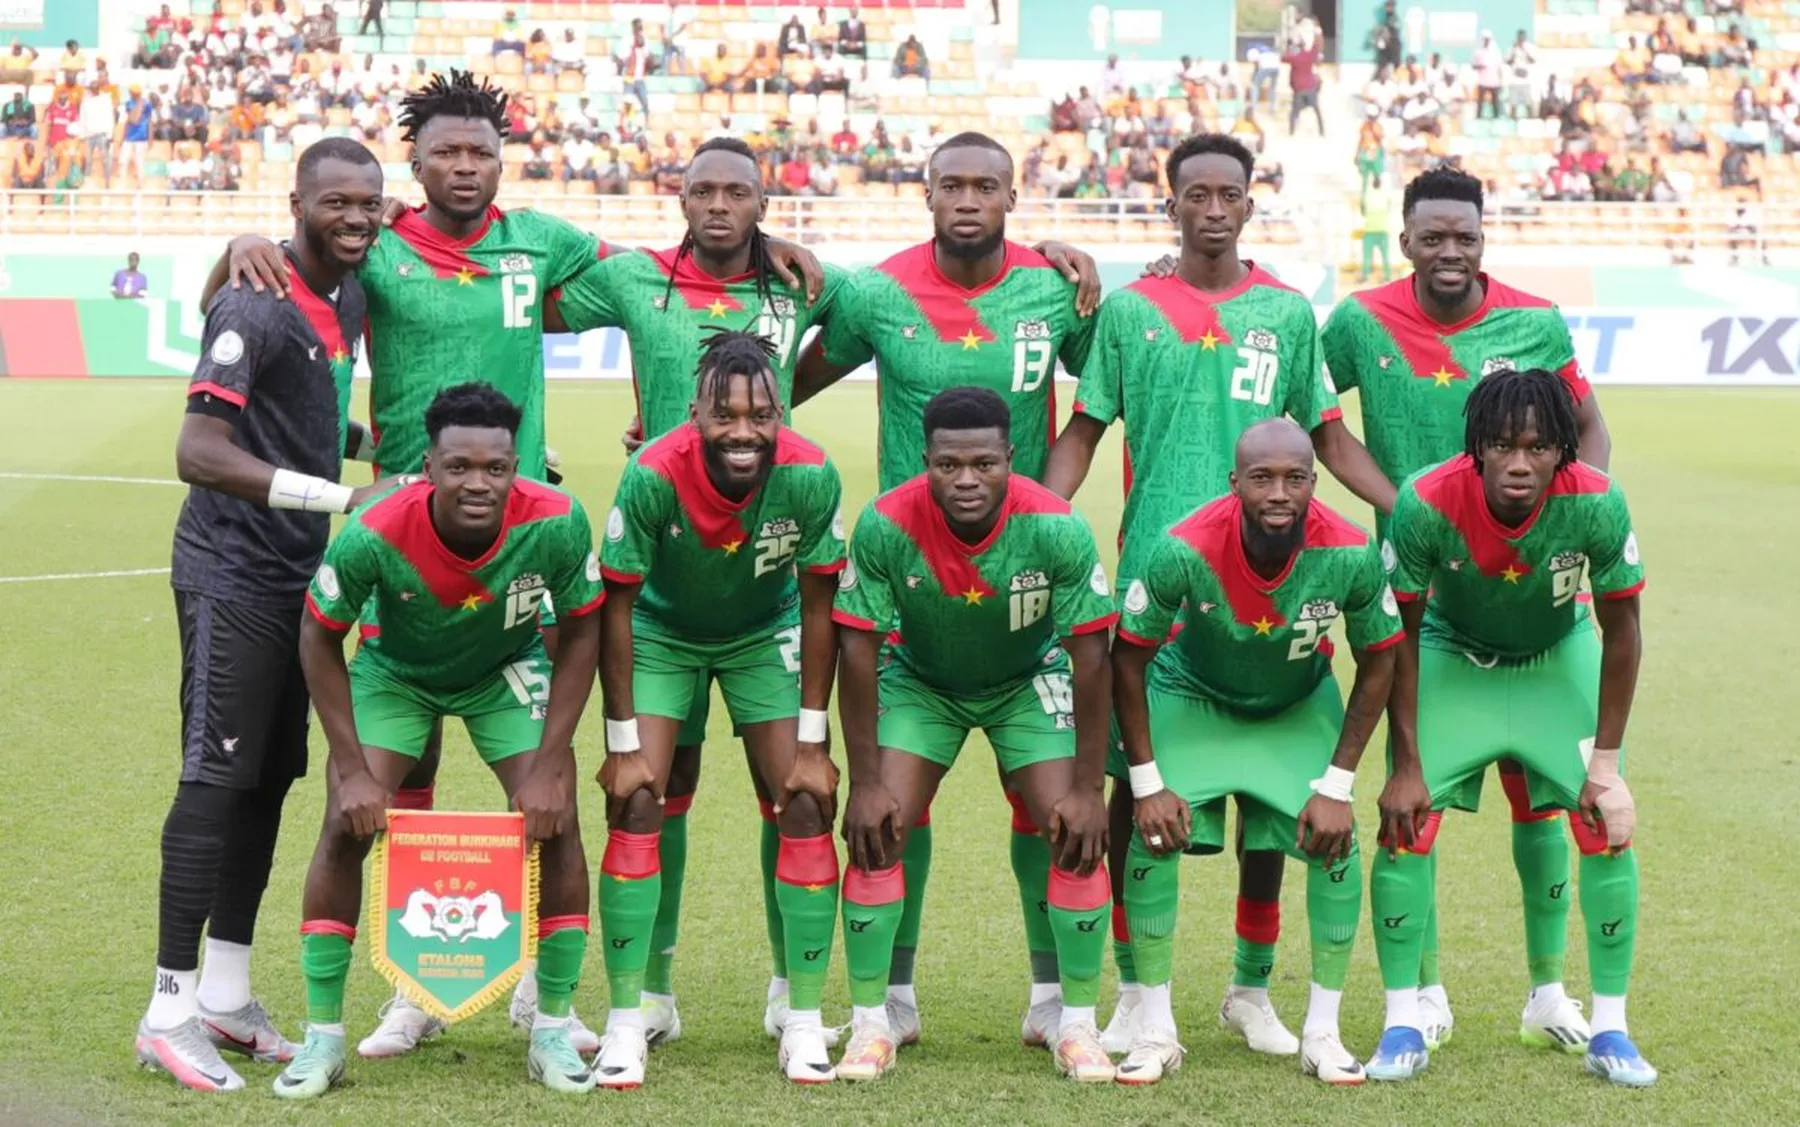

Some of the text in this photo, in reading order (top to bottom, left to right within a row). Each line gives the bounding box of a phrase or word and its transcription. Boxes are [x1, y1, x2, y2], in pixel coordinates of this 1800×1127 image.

[502, 273, 537, 329] 12
[1010, 340, 1052, 393] 13
[1230, 347, 1280, 406] 20
[754, 533, 802, 580] 25
[504, 586, 546, 631] 15
[1552, 565, 1581, 609] 9
[1009, 588, 1050, 633] 18
[774, 624, 802, 673] 2
[502, 660, 552, 705] 15
[1032, 674, 1074, 715] 18
[437, 850, 492, 864] FOOTBALL
